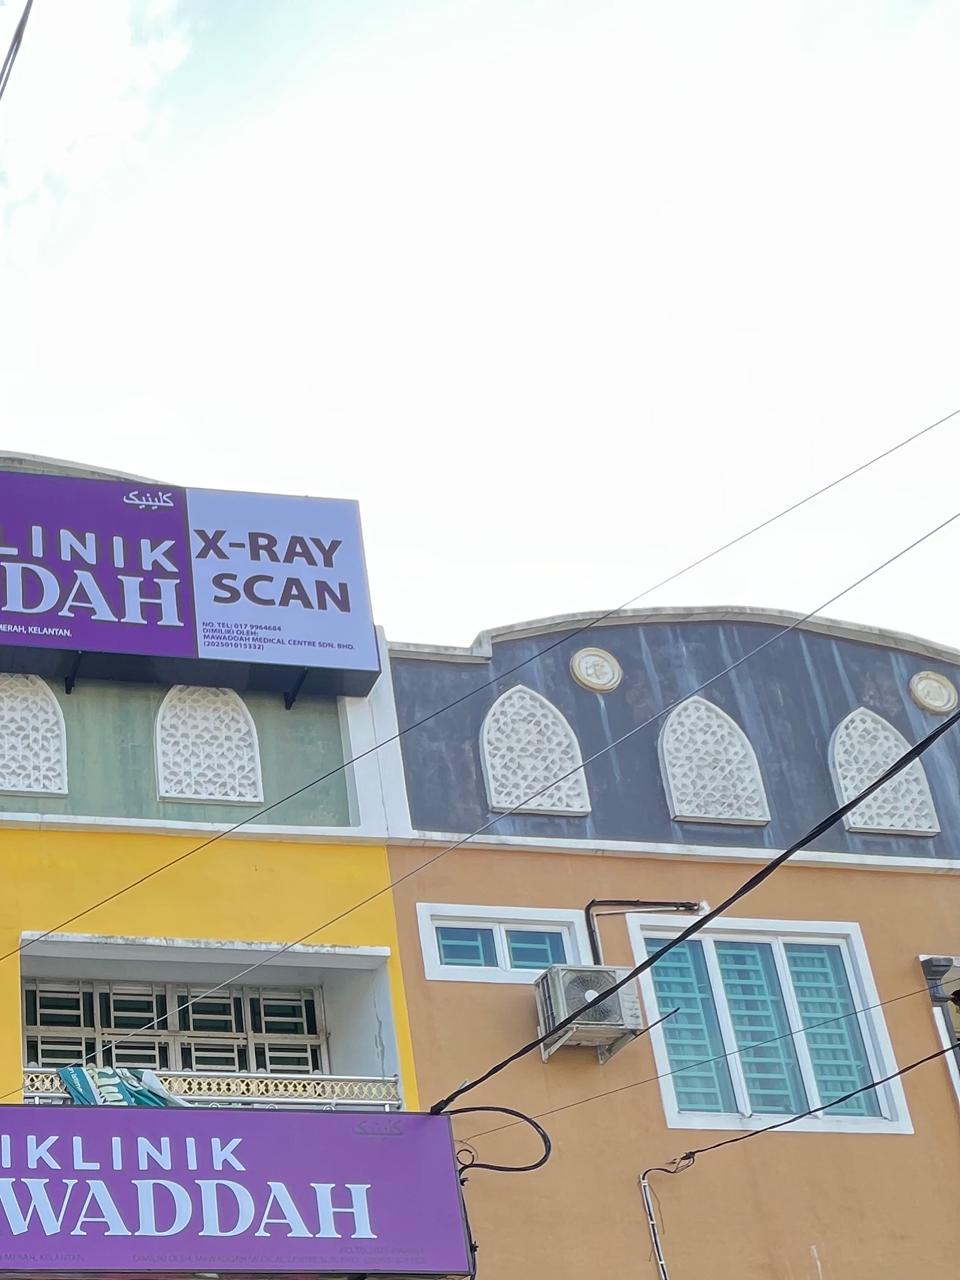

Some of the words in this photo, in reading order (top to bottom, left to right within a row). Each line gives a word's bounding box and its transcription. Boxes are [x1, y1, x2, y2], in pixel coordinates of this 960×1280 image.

[193, 529, 343, 568] X-RAY
[211, 572, 351, 613] SCAN
[28, 625, 72, 638] KELANTAN.
[202, 627, 235, 636] DIMILIKI
[203, 634, 251, 643] MAWADDAH
[251, 637, 286, 646] MEDICAL
[287, 639, 316, 648] CENTRE
